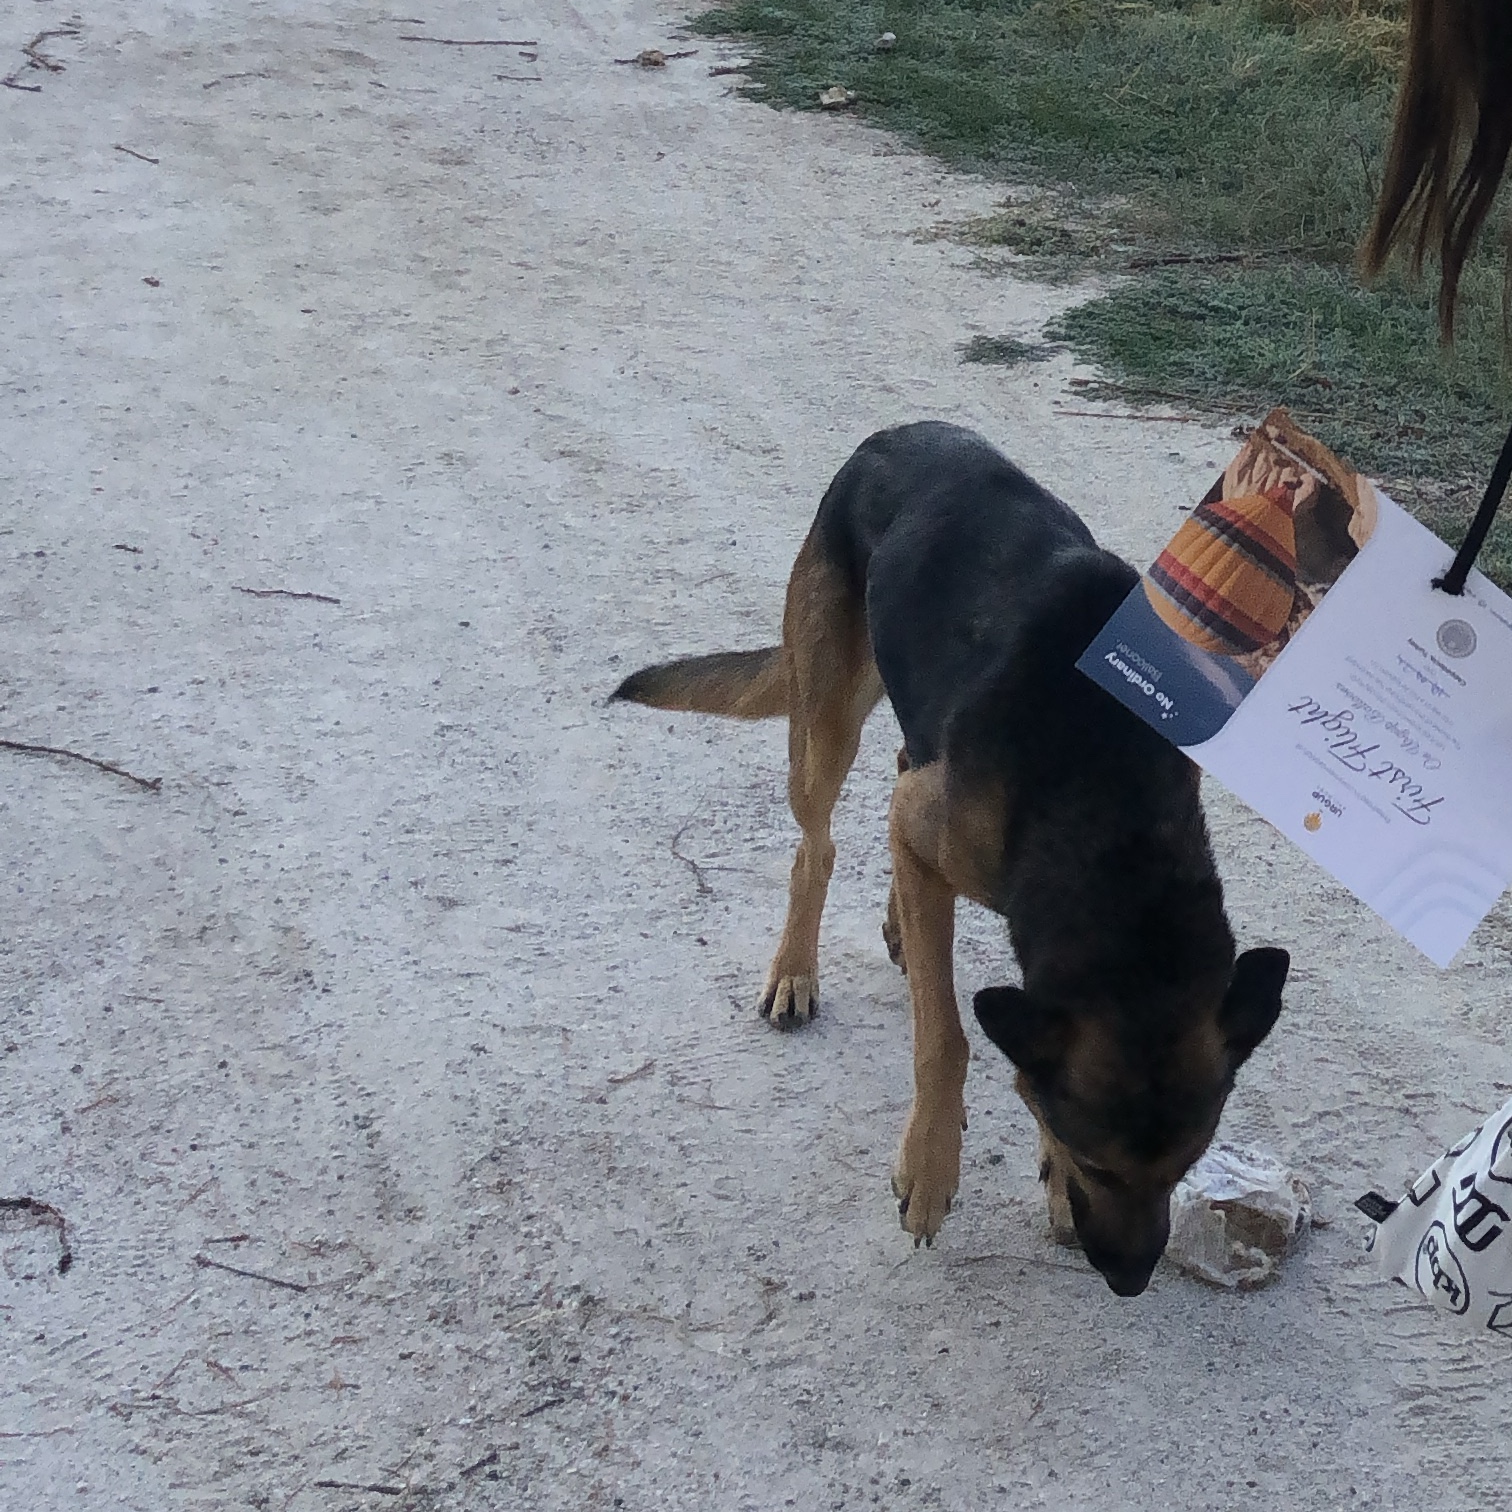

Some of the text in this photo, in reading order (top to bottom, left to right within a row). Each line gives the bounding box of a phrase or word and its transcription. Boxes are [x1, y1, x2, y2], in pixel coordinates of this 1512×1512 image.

[1104, 651, 1173, 710] No Ordinary
[1287, 695, 1380, 772] Flight
[1311, 790, 1342, 818] URGUP
[1367, 760, 1444, 825] First
